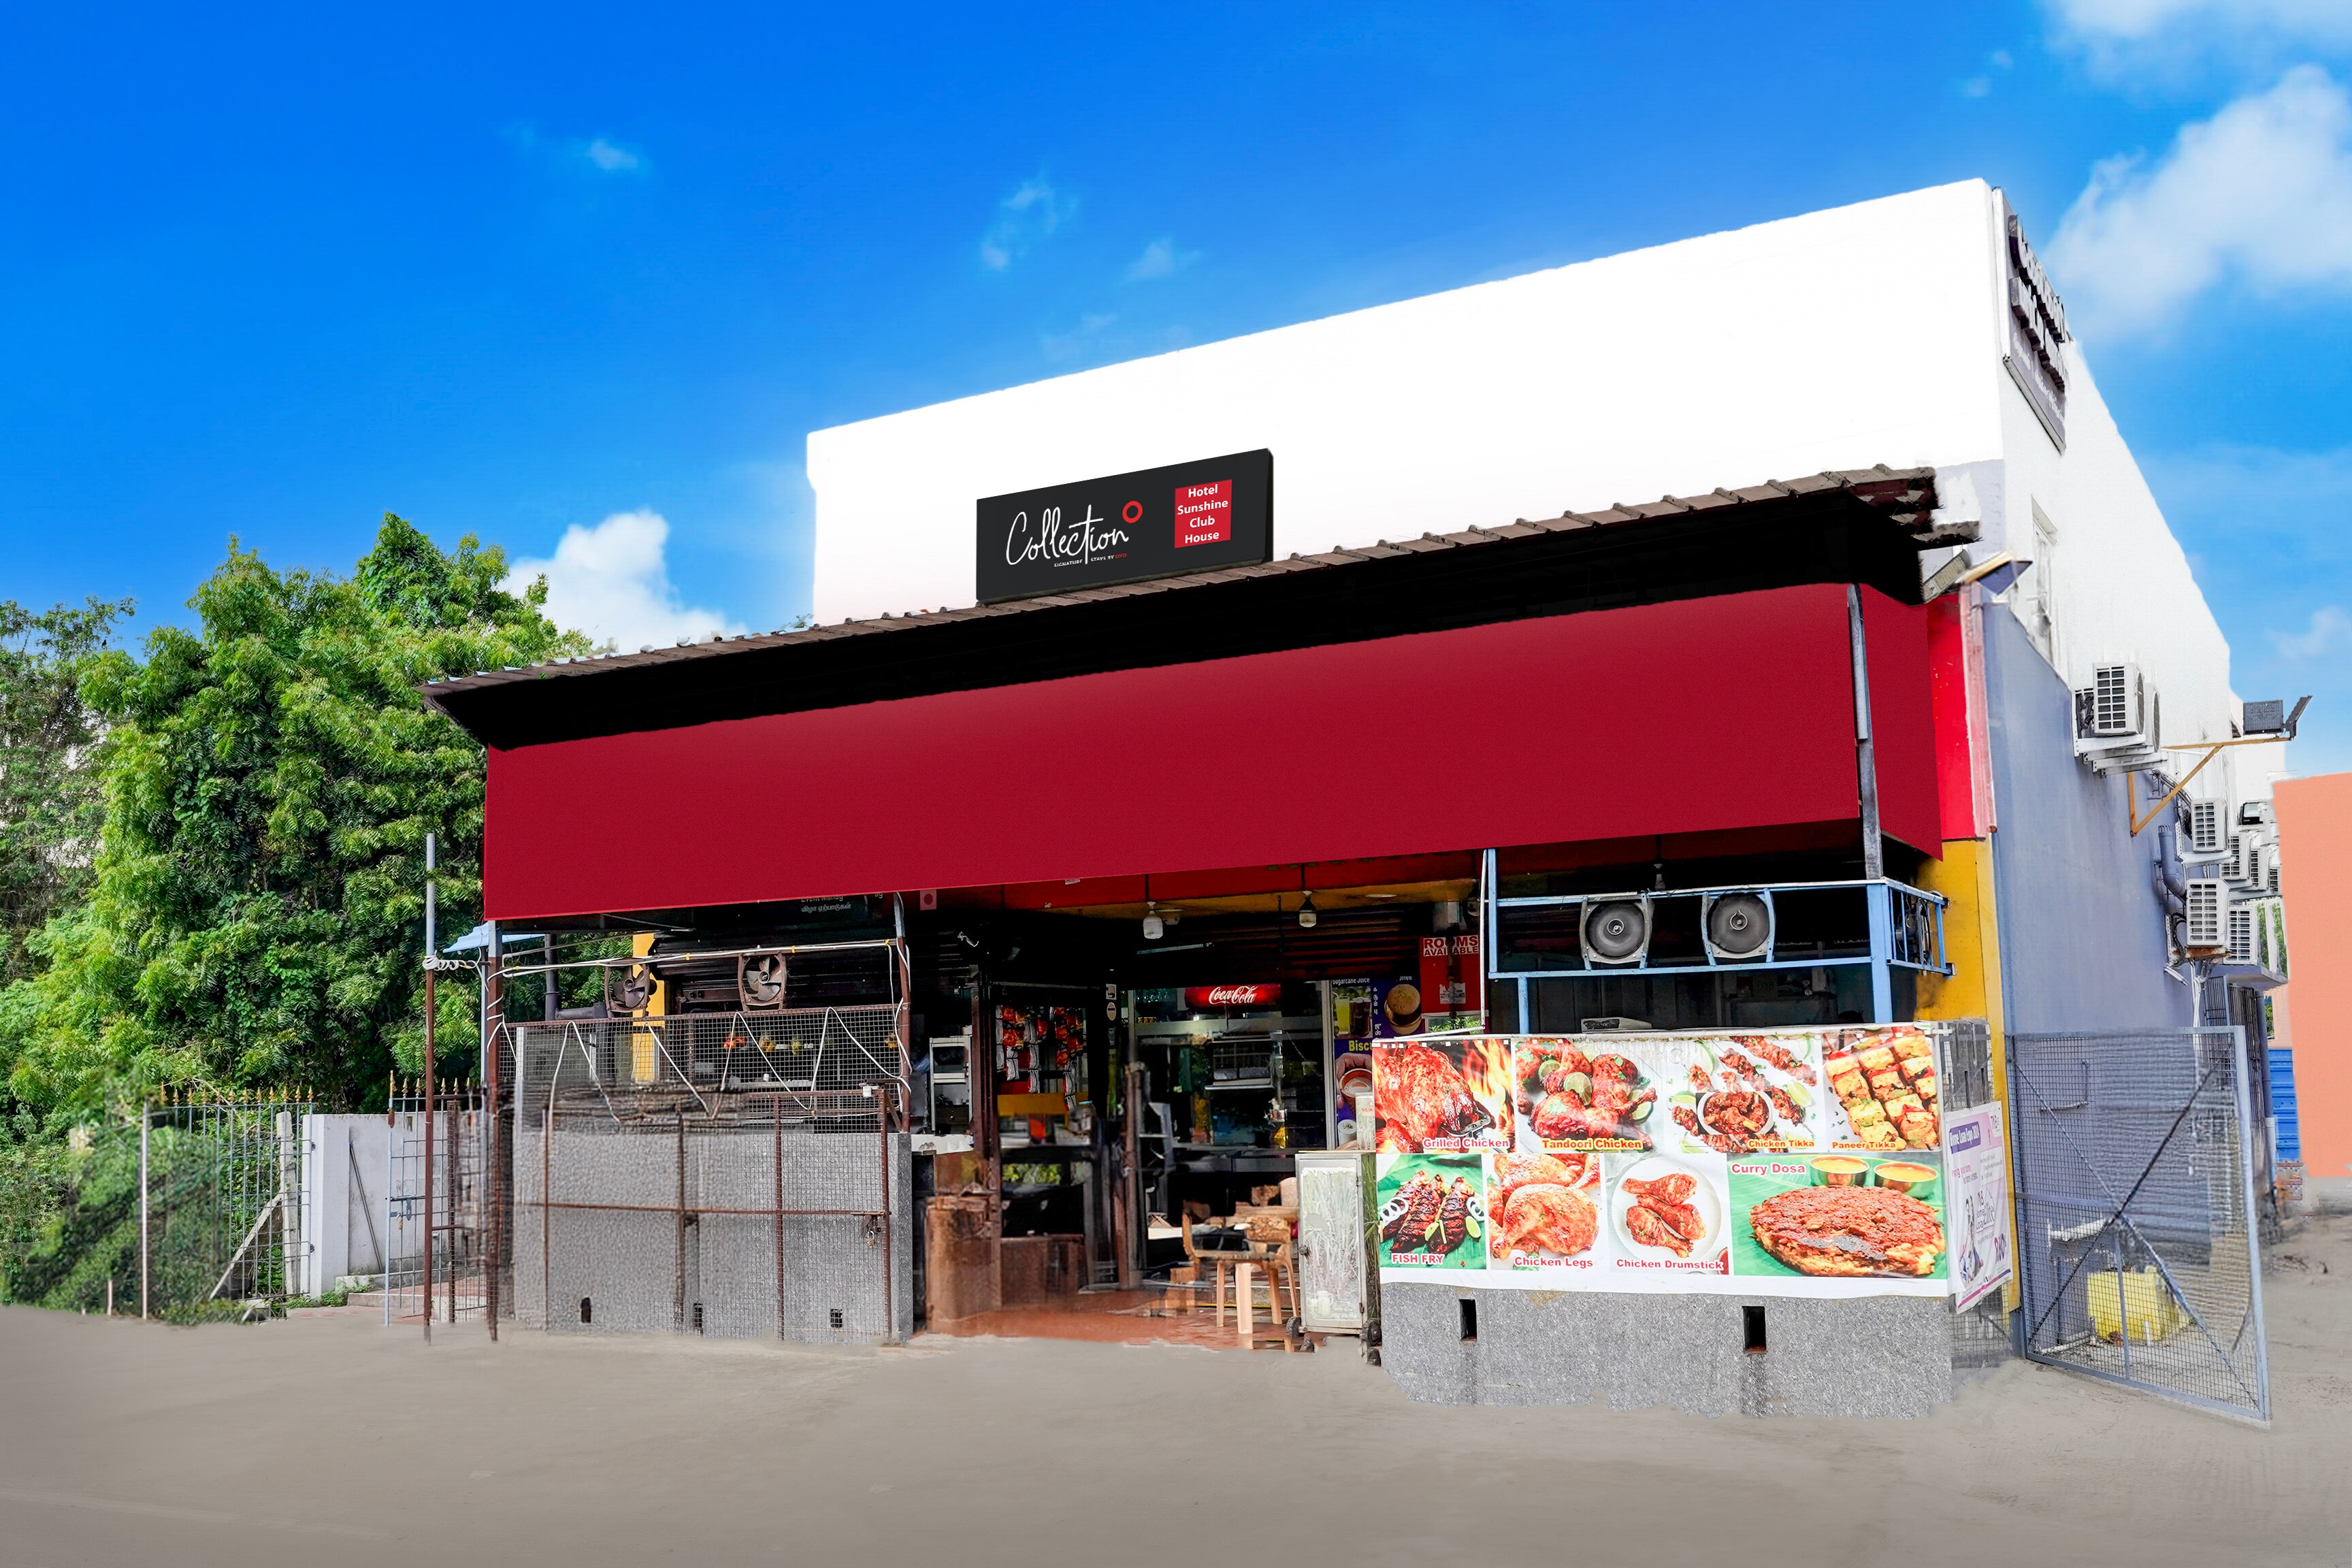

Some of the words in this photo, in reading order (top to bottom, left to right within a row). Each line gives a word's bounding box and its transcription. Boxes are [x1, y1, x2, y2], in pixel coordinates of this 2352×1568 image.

[1188, 484, 1218, 497] Hotel
[1177, 500, 1228, 515] Sunshine
[1190, 515, 1215, 528] Club
[1006, 504, 1129, 565] Collection
[1185, 532, 1220, 544] House
[1423, 1139, 1459, 1147] Grilled
[1463, 1139, 1509, 1147] Chicken
[1542, 1140, 1592, 1148] Tandoori
[1596, 1139, 1642, 1148] Chicken
[1731, 1164, 1767, 1175] Curry
[1772, 1164, 1806, 1173] Dosa
[1392, 1254, 1418, 1263] FISH
[1422, 1255, 1443, 1264] FRY
[1514, 1256, 1561, 1266] Chicken
[1565, 1258, 1593, 1269] Legs
[1616, 1259, 1661, 1268] Chicken
[1665, 1260, 1722, 1269] Drumstick
